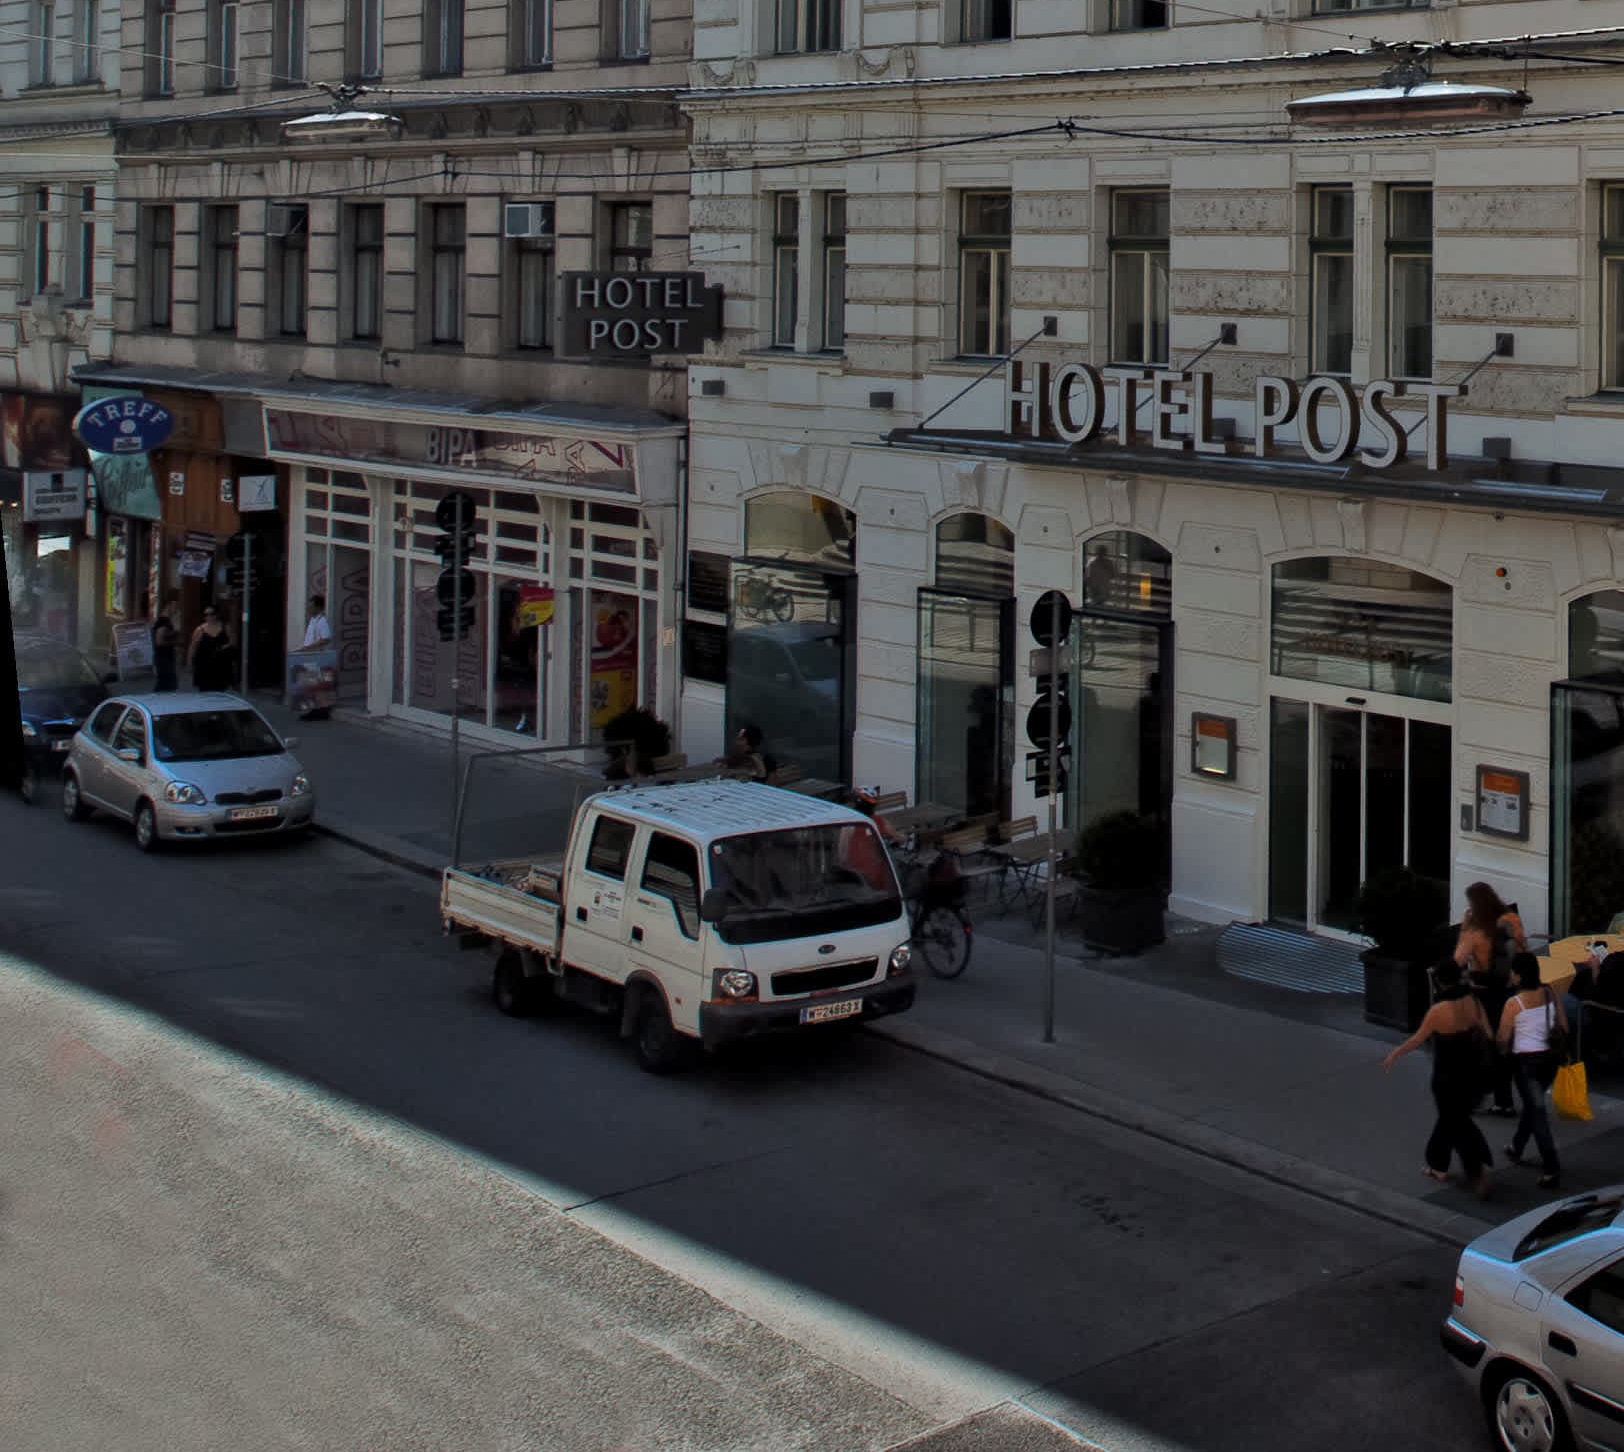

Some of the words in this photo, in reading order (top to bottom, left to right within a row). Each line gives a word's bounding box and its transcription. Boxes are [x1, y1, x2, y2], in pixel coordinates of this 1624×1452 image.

[576, 278, 704, 309] HOTEL
[590, 319, 689, 351] POST
[86, 400, 168, 429] TREFF
[1003, 360, 1228, 455] HOTEL
[1255, 376, 1468, 471] POST
[427, 428, 477, 468] BIPA
